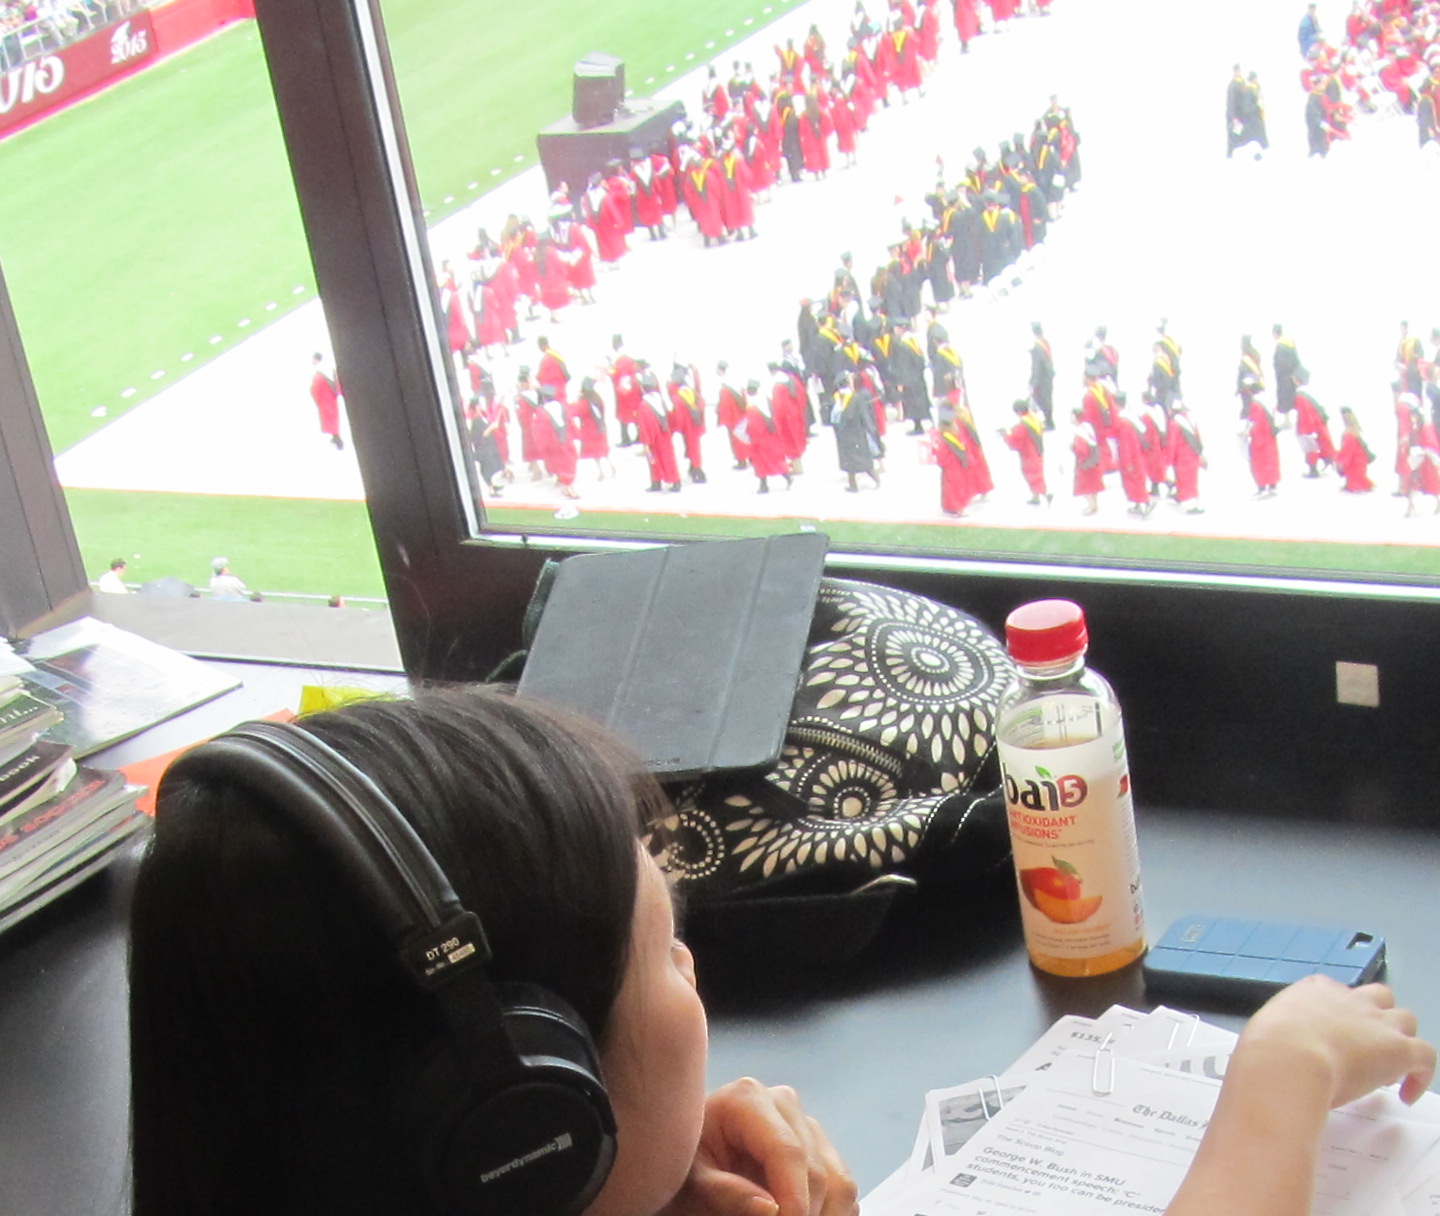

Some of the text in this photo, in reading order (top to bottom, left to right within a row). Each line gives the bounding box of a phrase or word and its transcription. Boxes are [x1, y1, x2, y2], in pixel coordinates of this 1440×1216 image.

[426, 937, 460, 961] DT 290
[1132, 1103, 1199, 1129] The Dallas
[480, 1141, 558, 1184] beyerdynamic
[966, 1162, 1021, 1183] students,
[1022, 1177, 1048, 1191] you
[1047, 1180, 1069, 1194] too
[1070, 1185, 1094, 1199] can
[1095, 1191, 1113, 1204] be
[974, 1155, 1071, 1184] commencement
[1071, 1178, 1119, 1197] speech:
[983, 1146, 1127, 1187] George W. Bush in SMU
